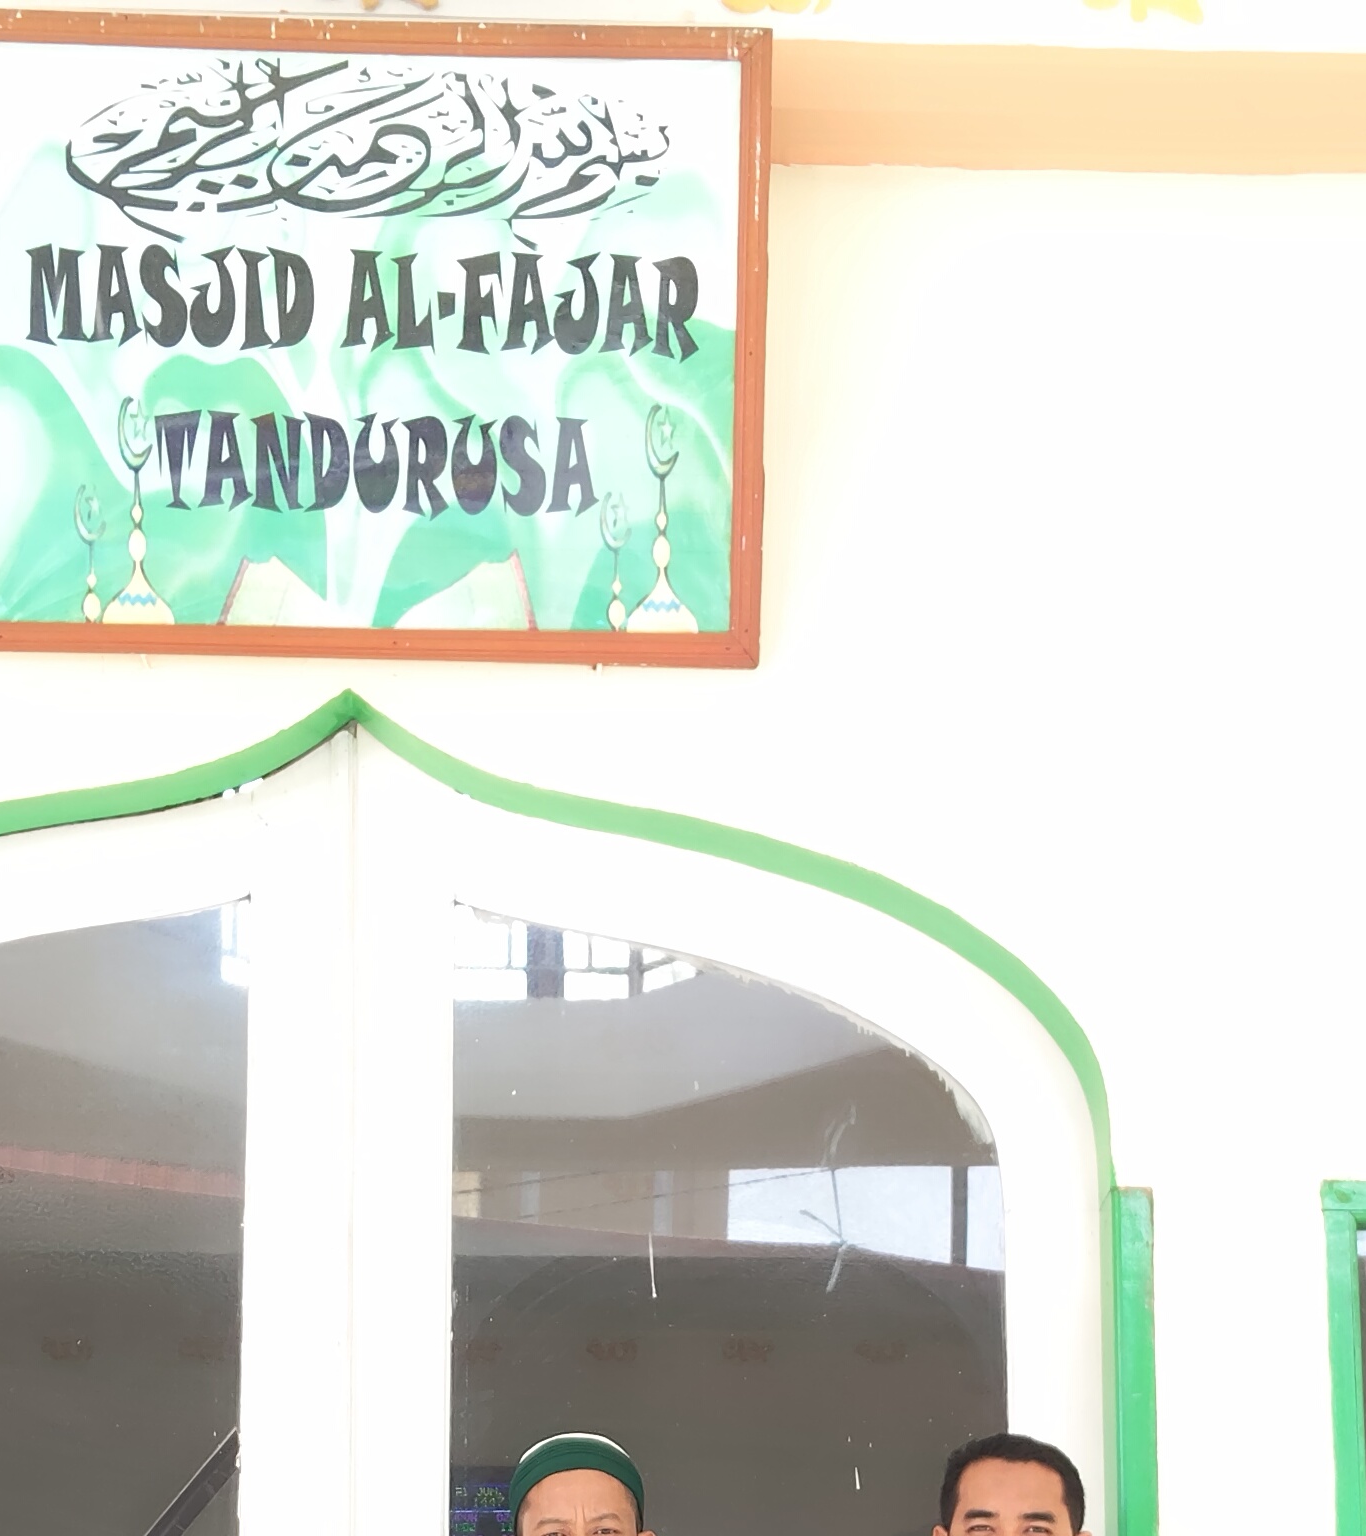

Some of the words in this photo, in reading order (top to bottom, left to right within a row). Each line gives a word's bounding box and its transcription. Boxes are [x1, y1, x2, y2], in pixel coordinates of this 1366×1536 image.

[26, 243, 315, 351] MASJID
[340, 249, 699, 362] AL-FAJAR
[154, 410, 599, 519] TANDURUSA
